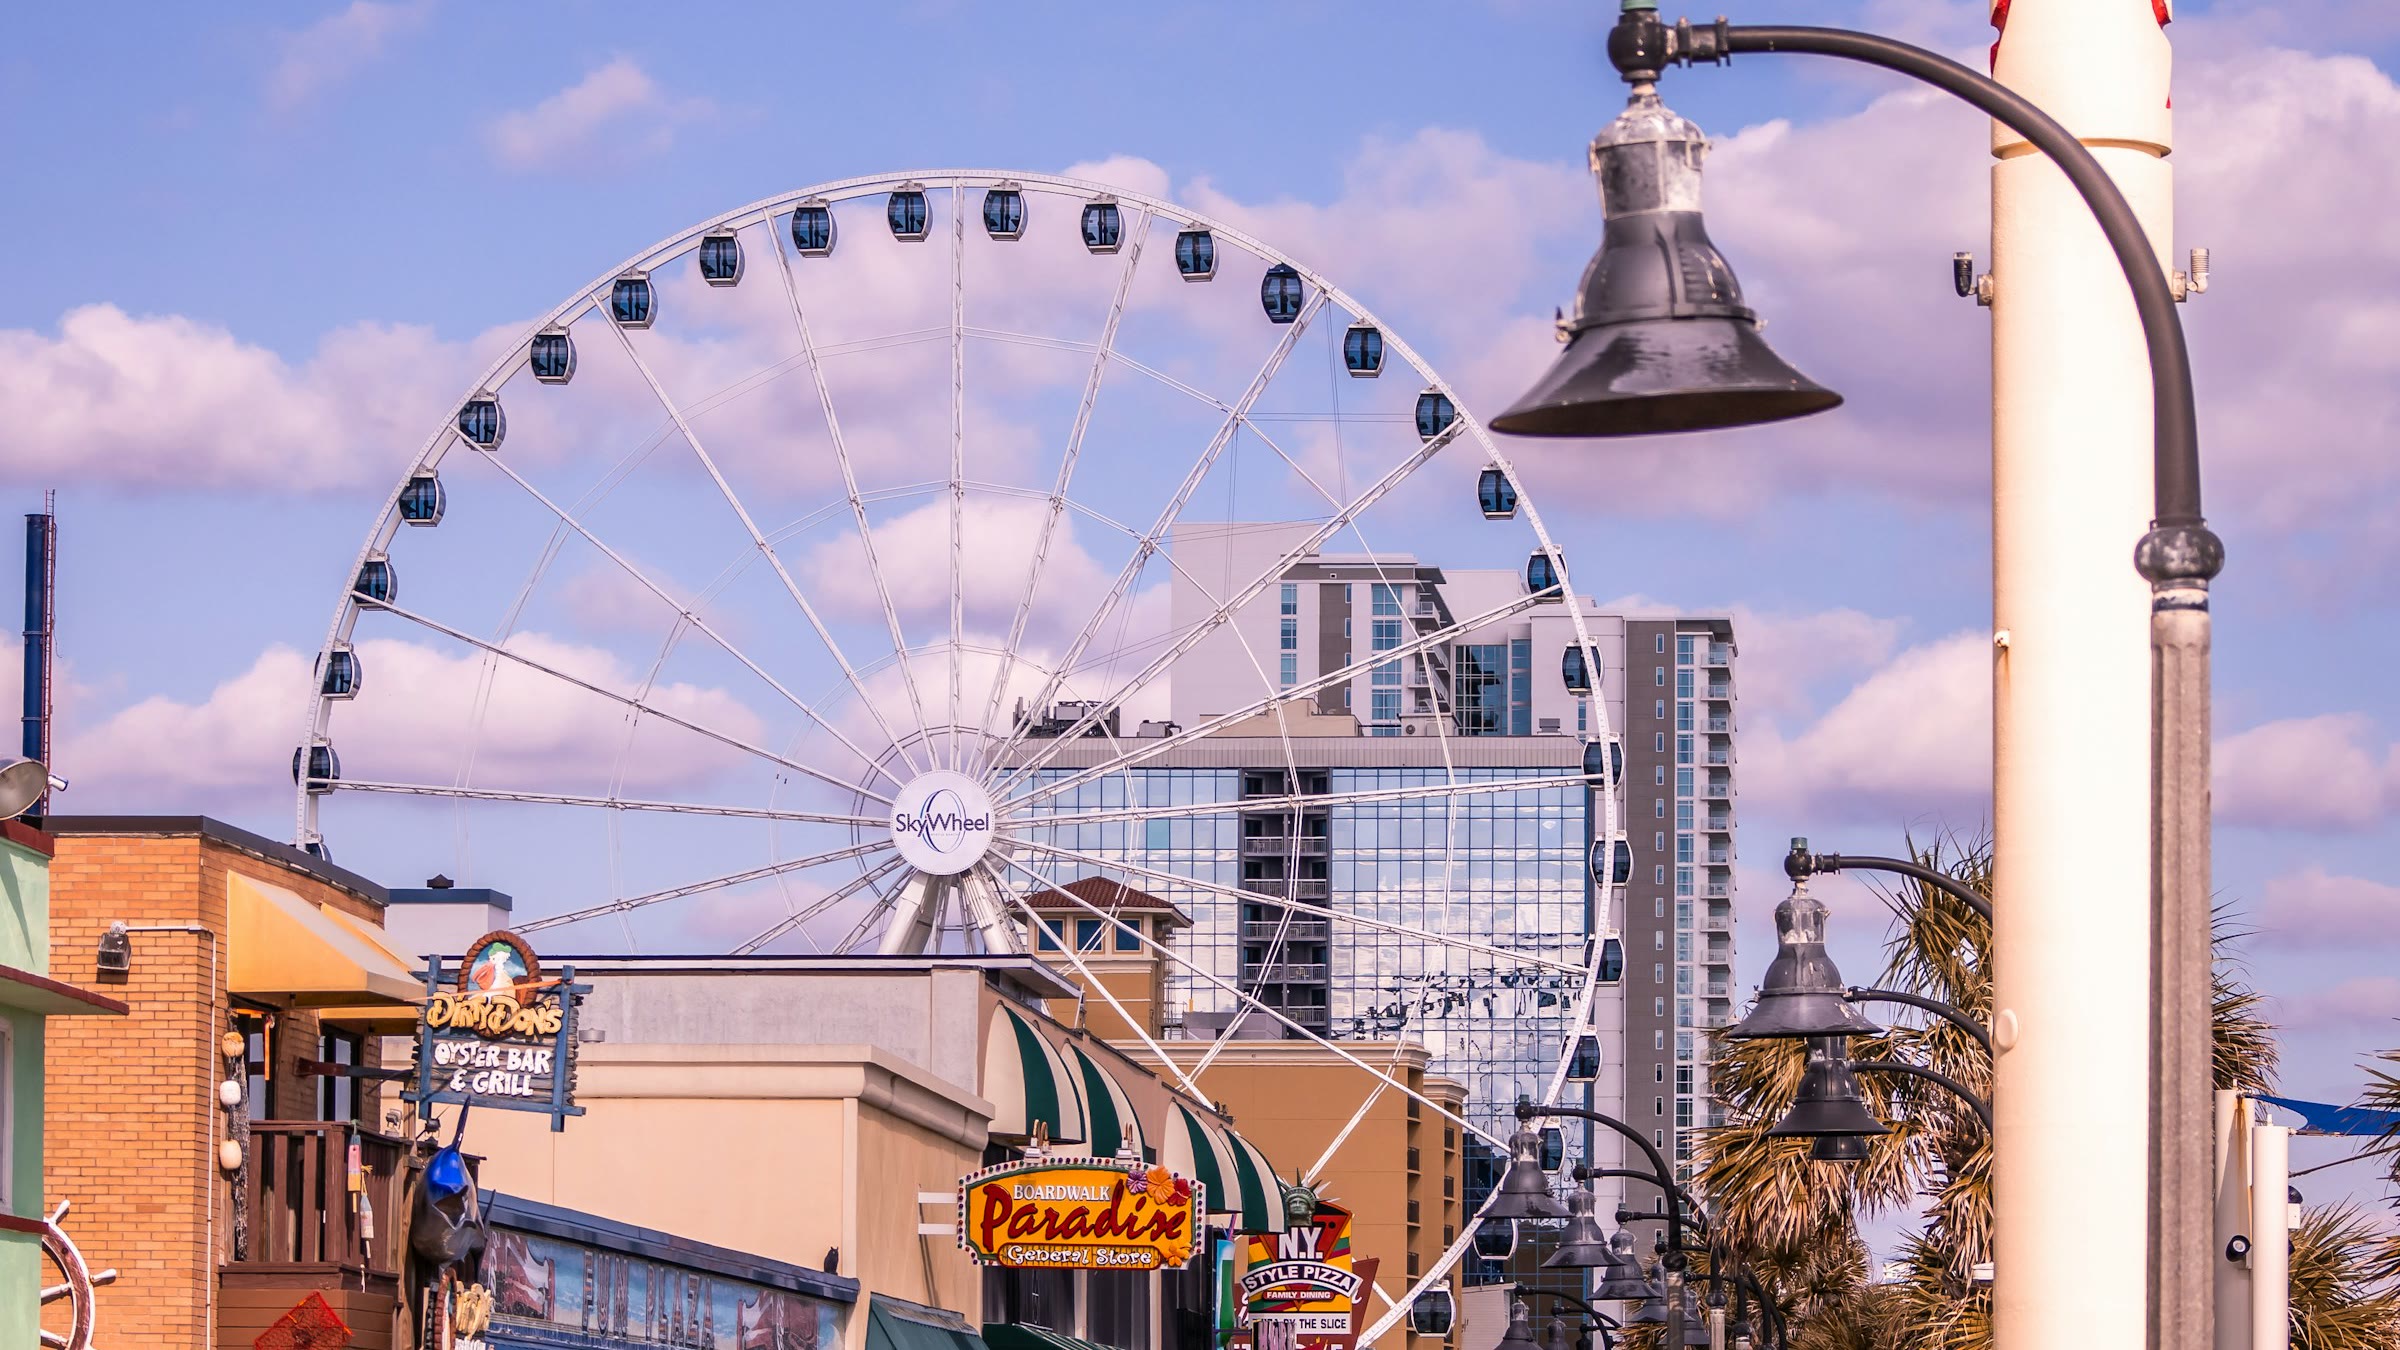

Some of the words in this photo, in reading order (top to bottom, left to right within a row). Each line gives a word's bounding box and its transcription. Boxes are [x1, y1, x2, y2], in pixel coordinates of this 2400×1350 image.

[895, 812, 990, 838] SkyWheel
[434, 1041, 500, 1068] OYSTER
[507, 1048, 552, 1075] BAR
[450, 1069, 467, 1092] &
[472, 1071, 533, 1096] GRILL
[1013, 1185, 1111, 1202] BOARDWALK
[981, 1178, 1186, 1253] Paradise
[1007, 1245, 1090, 1265] General
[1095, 1248, 1153, 1265] Store
[1278, 1226, 1324, 1260] N.Y.
[1244, 1265, 1300, 1290] STYLE
[1303, 1266, 1351, 1291] PIZZA
[582, 1250, 629, 1340] FUN
[1266, 1291, 1298, 1299] FAMILY
[1300, 1291, 1331, 1299] DINING
[1299, 1318, 1317, 1329] THE
[1320, 1318, 1346, 1329] SLICE
